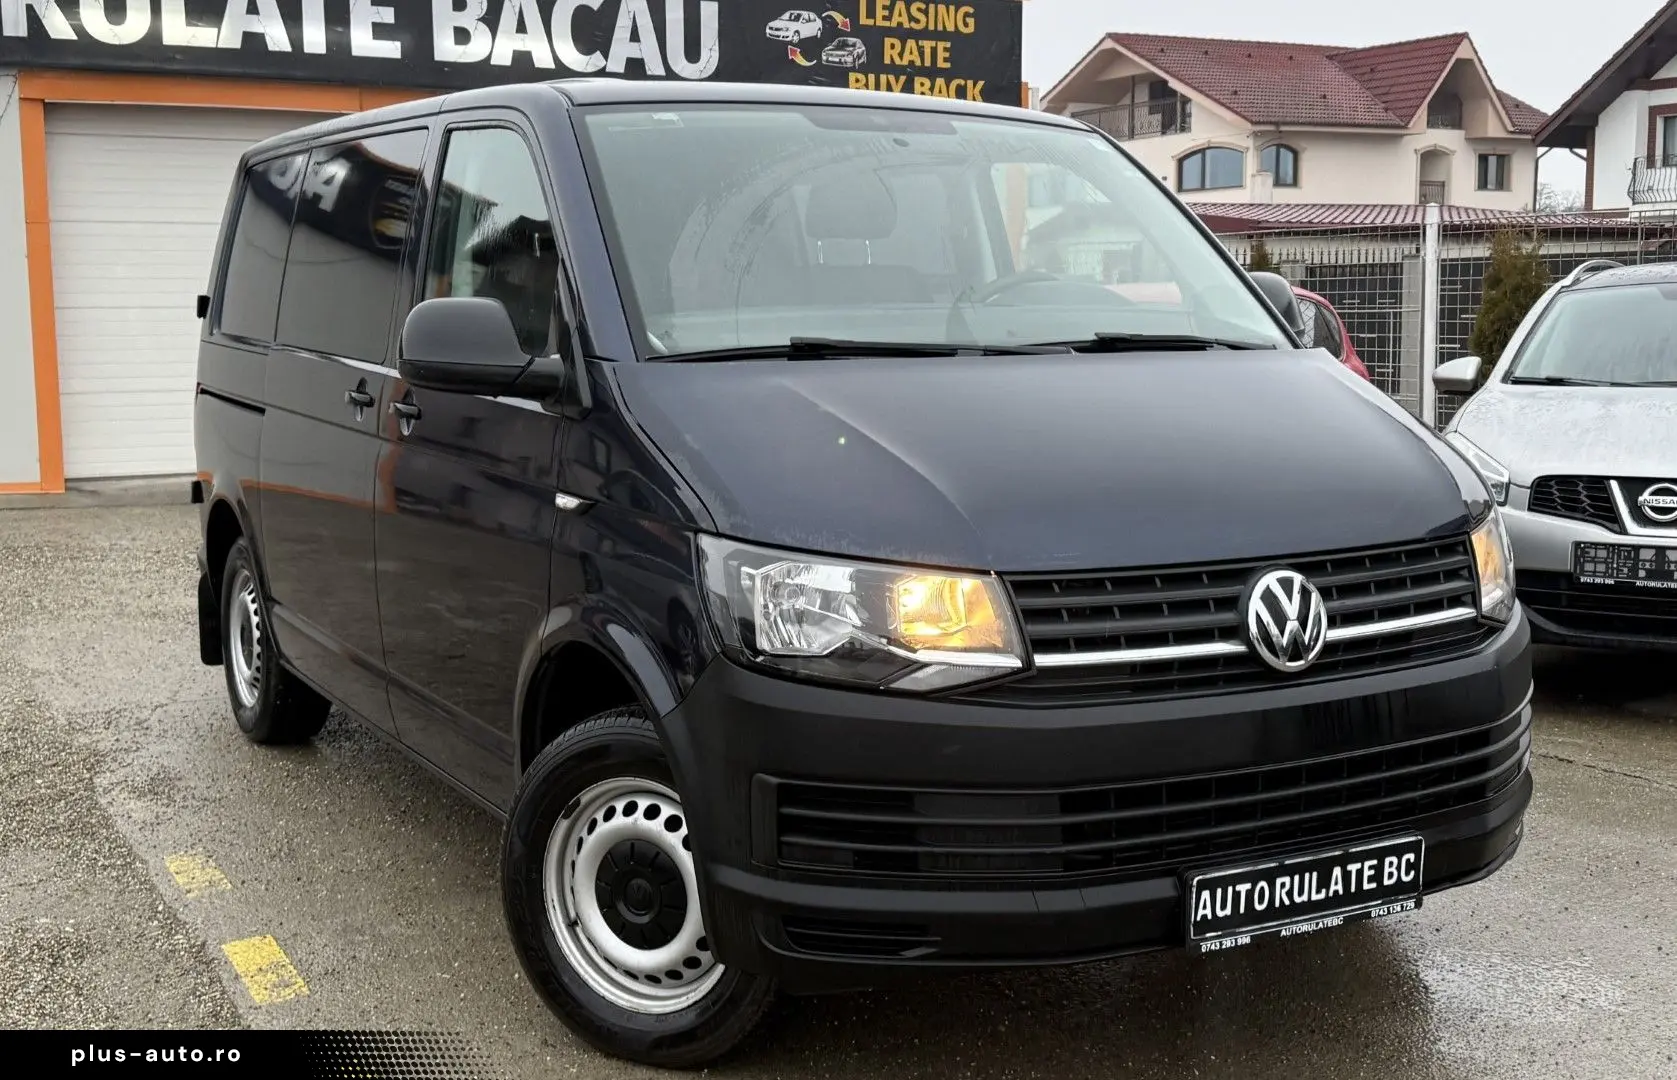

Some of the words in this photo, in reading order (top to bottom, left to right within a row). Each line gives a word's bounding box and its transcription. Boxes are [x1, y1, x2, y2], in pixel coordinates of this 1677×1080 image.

[860, 0, 974, 33] LEASING
[432, 0, 720, 79] BACAU
[883, 37, 952, 68] RATE
[914, 78, 985, 102] BACK
[1383, 852, 1415, 886] BC
[1371, 905, 1388, 917] 0743
[1402, 901, 1415, 911] 729
[1280, 917, 1344, 937] AUTORULATEBC
[1201, 942, 1220, 953] 0743
